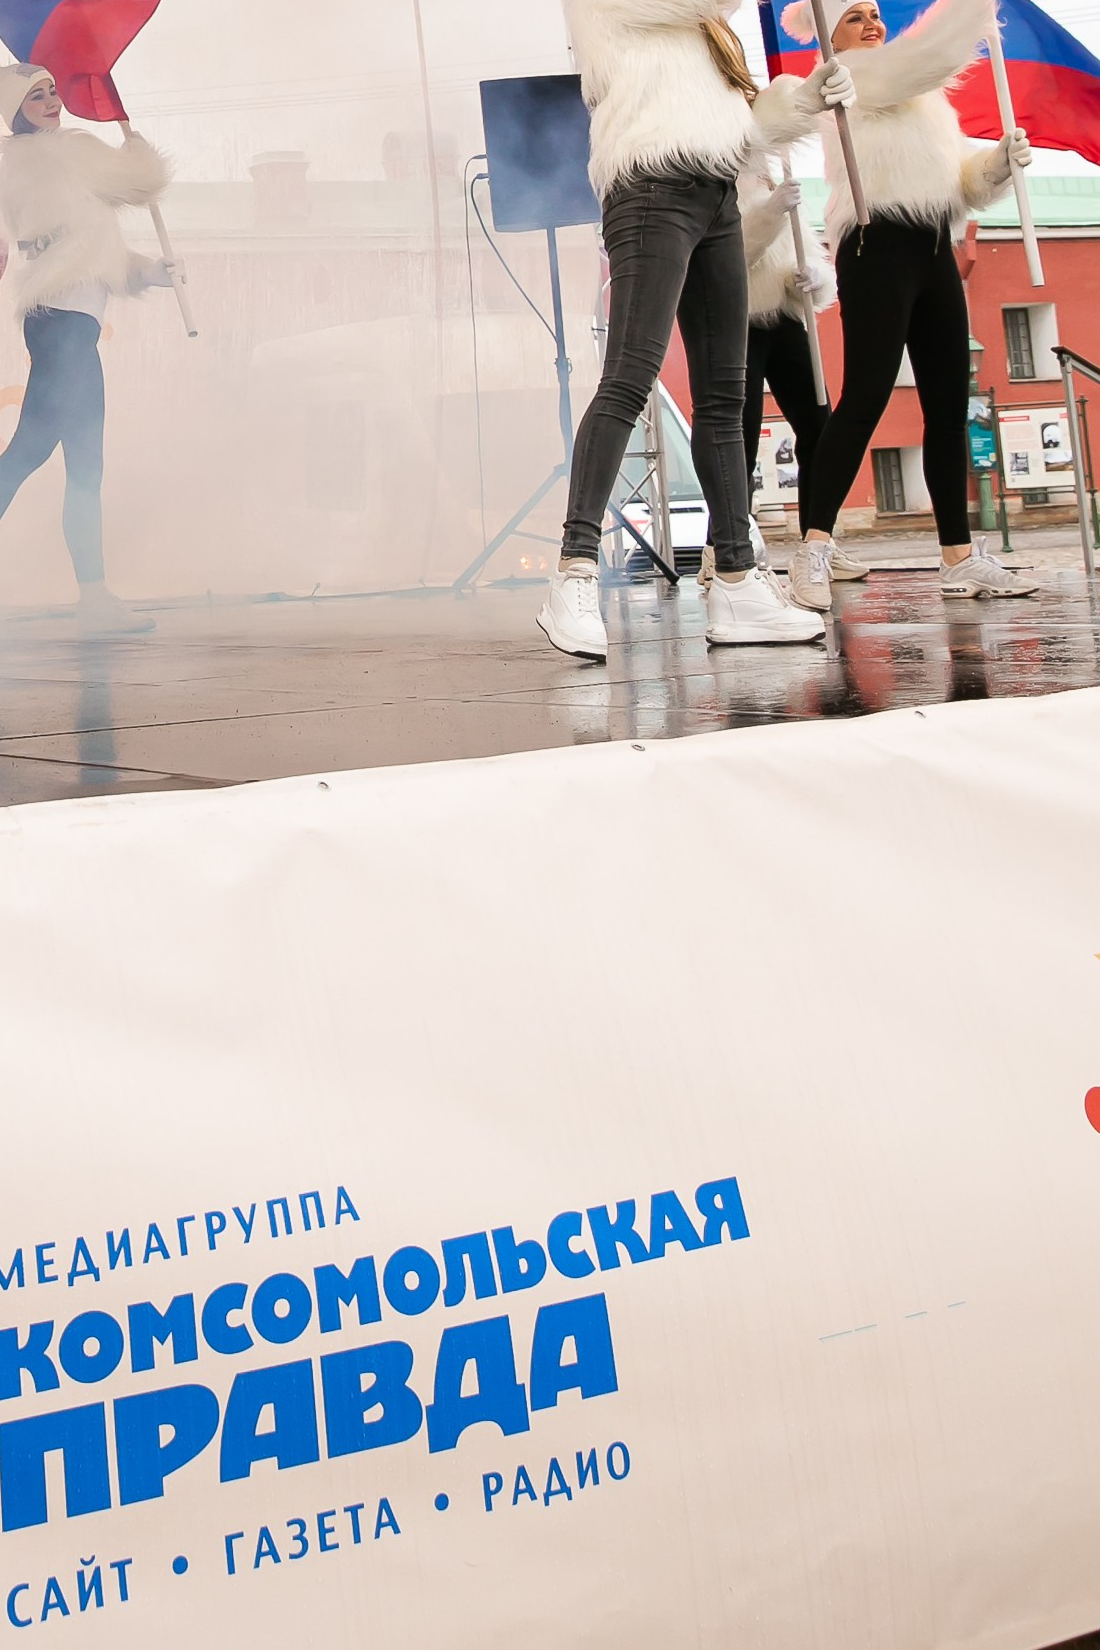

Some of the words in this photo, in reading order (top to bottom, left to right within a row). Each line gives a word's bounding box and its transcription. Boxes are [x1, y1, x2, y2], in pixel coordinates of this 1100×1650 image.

[6, 1555, 133, 1628] САЙТ
[225, 1498, 401, 1575] ГАЗЕТА
[483, 1441, 631, 1513] РАДИО
